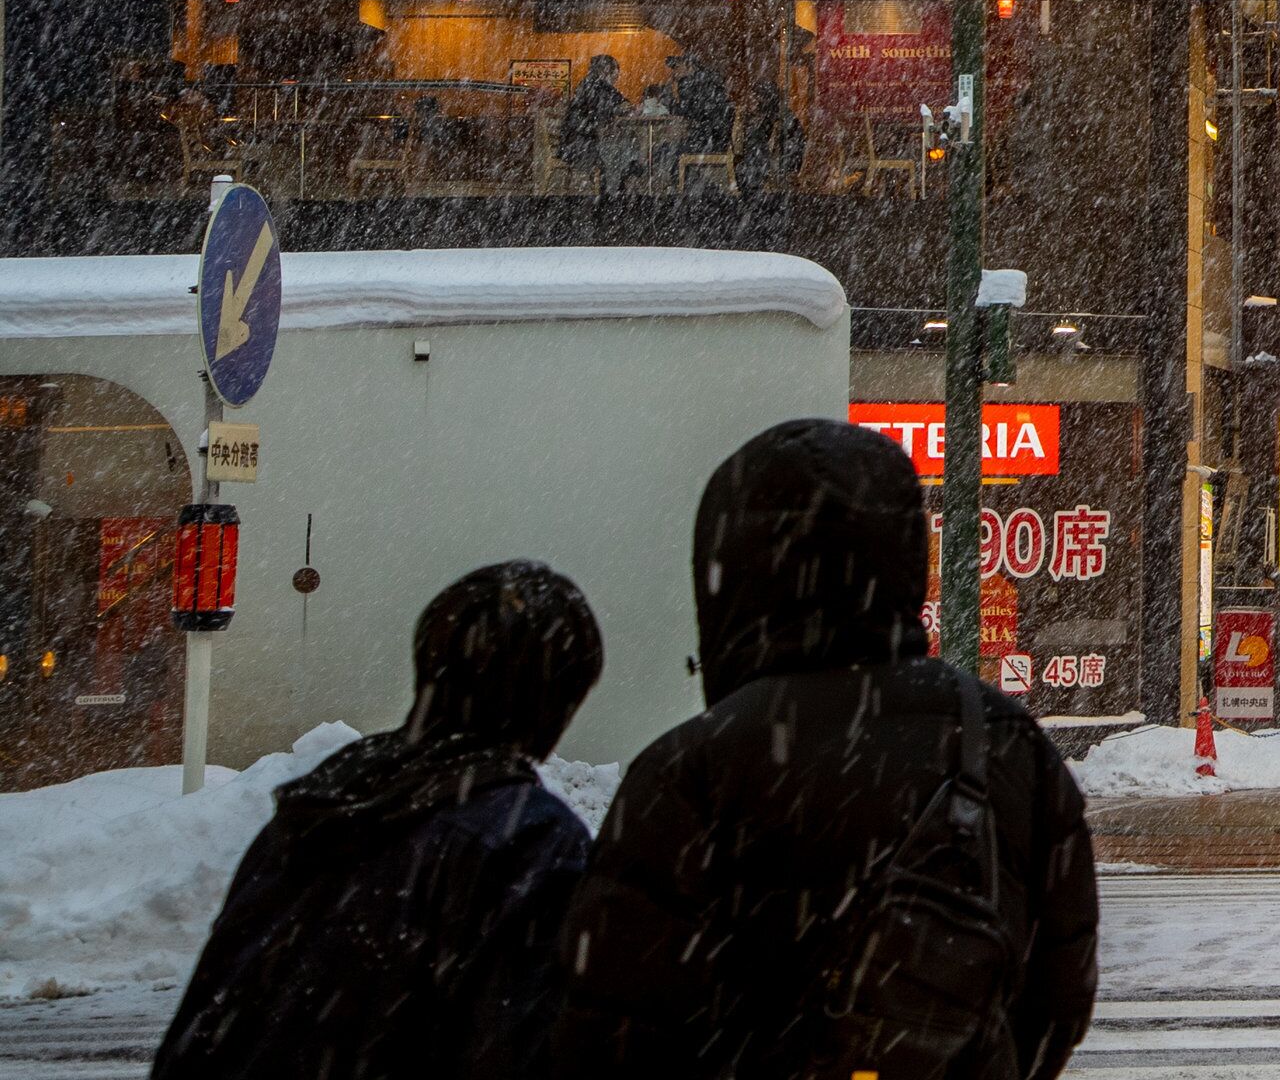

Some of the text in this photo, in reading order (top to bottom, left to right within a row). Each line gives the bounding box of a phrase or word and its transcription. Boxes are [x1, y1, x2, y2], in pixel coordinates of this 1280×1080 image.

[830, 44, 870, 59] with
[930, 504, 1112, 582] 90席
[1042, 654, 1106, 688] 45席
[1221, 696, 1269, 709] 札幌中央店
